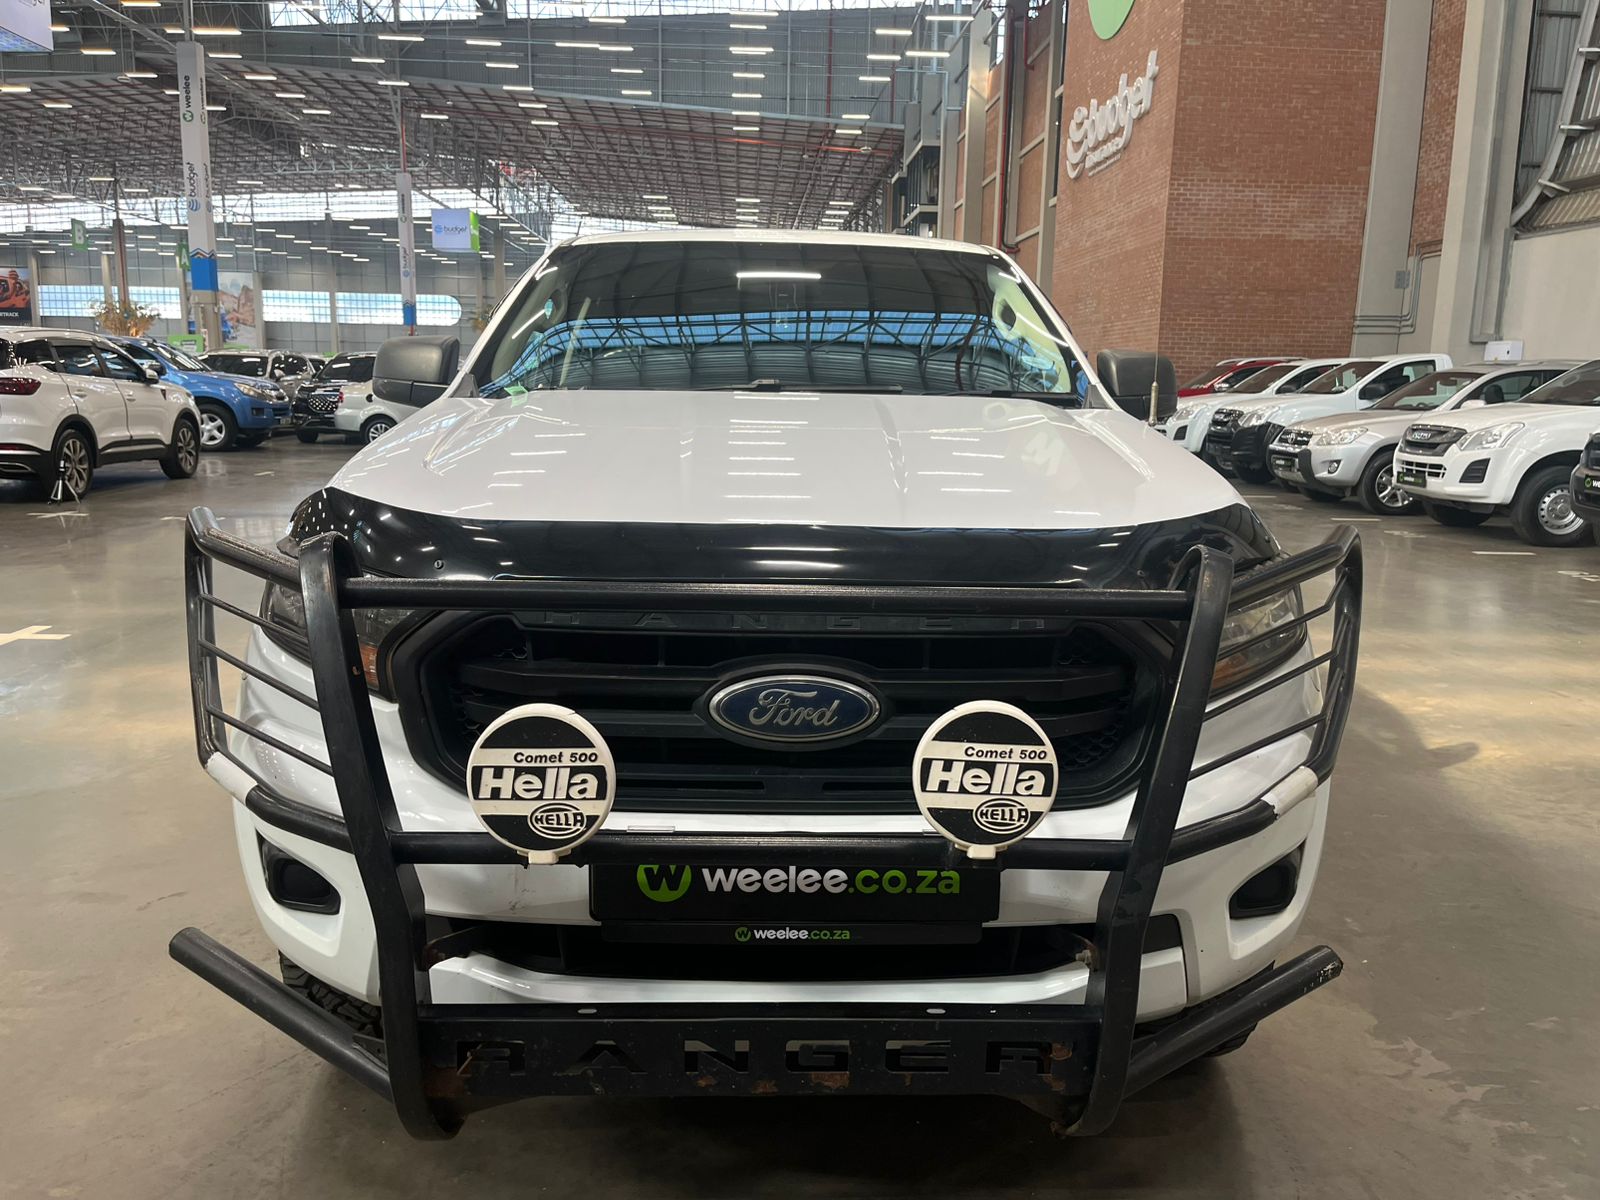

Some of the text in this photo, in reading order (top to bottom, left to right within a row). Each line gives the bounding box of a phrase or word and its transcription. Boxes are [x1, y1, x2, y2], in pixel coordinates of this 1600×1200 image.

[183, 75, 191, 109] weelee
[1087, 48, 1160, 151] budget
[187, 162, 198, 197] budget
[74, 223, 84, 244] B
[443, 224, 467, 234] budget
[181, 248, 189, 266] A
[749, 688, 841, 727] Ford
[513, 751, 599, 764] Comet 500
[964, 746, 1048, 760] Comet 500
[478, 767, 599, 800] Hella
[925, 759, 1046, 796] Hella
[534, 810, 585, 828] HELLA
[979, 807, 1029, 824] HELLA
[701, 865, 961, 895] weelee.co.za
[753, 927, 850, 941] weelee.co.za
[456, 1040, 1053, 1075] RANGER
